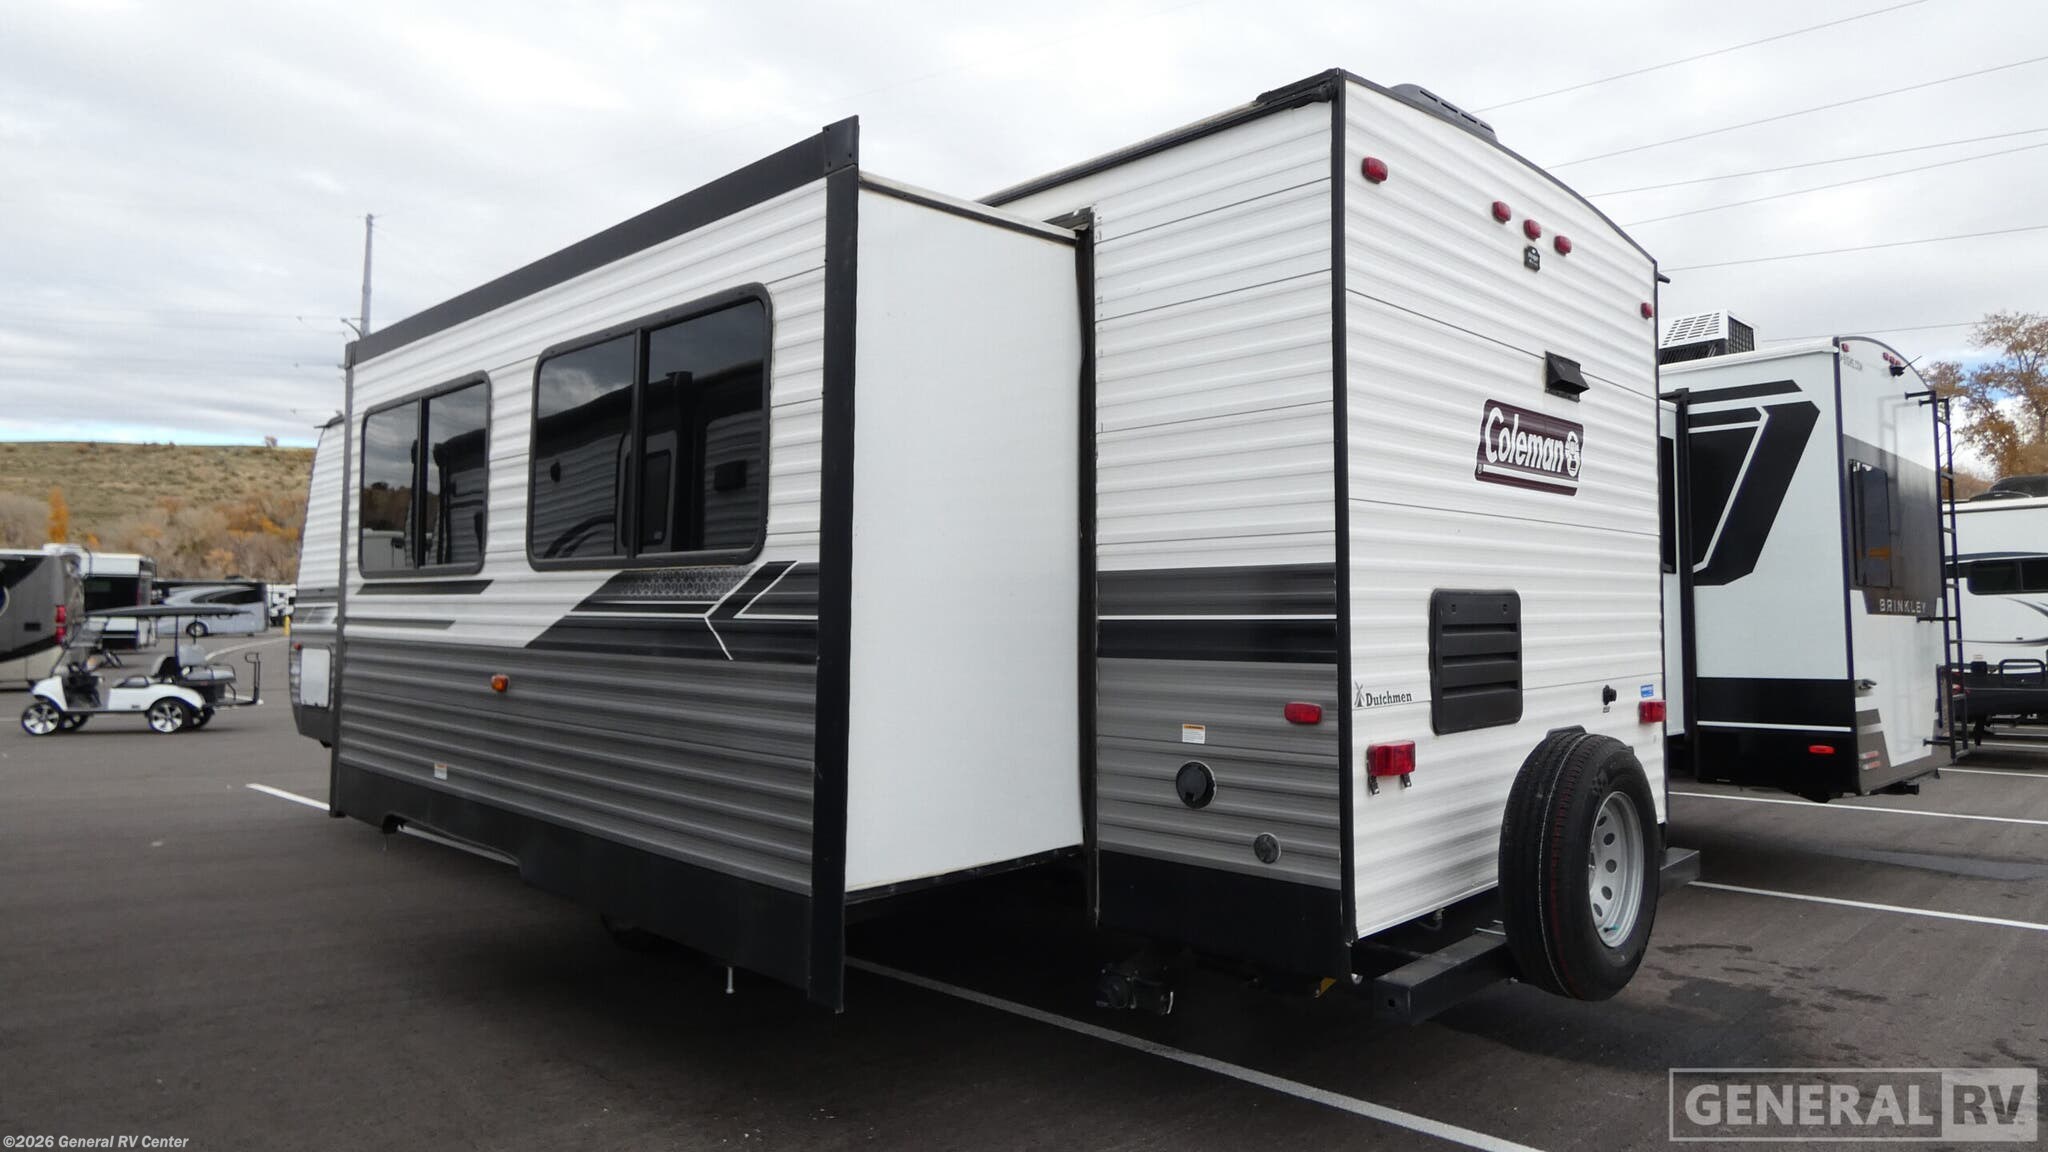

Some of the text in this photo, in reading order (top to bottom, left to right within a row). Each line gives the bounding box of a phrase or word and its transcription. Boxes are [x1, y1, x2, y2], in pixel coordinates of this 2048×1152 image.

[1485, 407, 1564, 473] Coleman
[1880, 598, 1927, 614] BRINKLEY
[1366, 690, 1412, 706] Dutchmen
